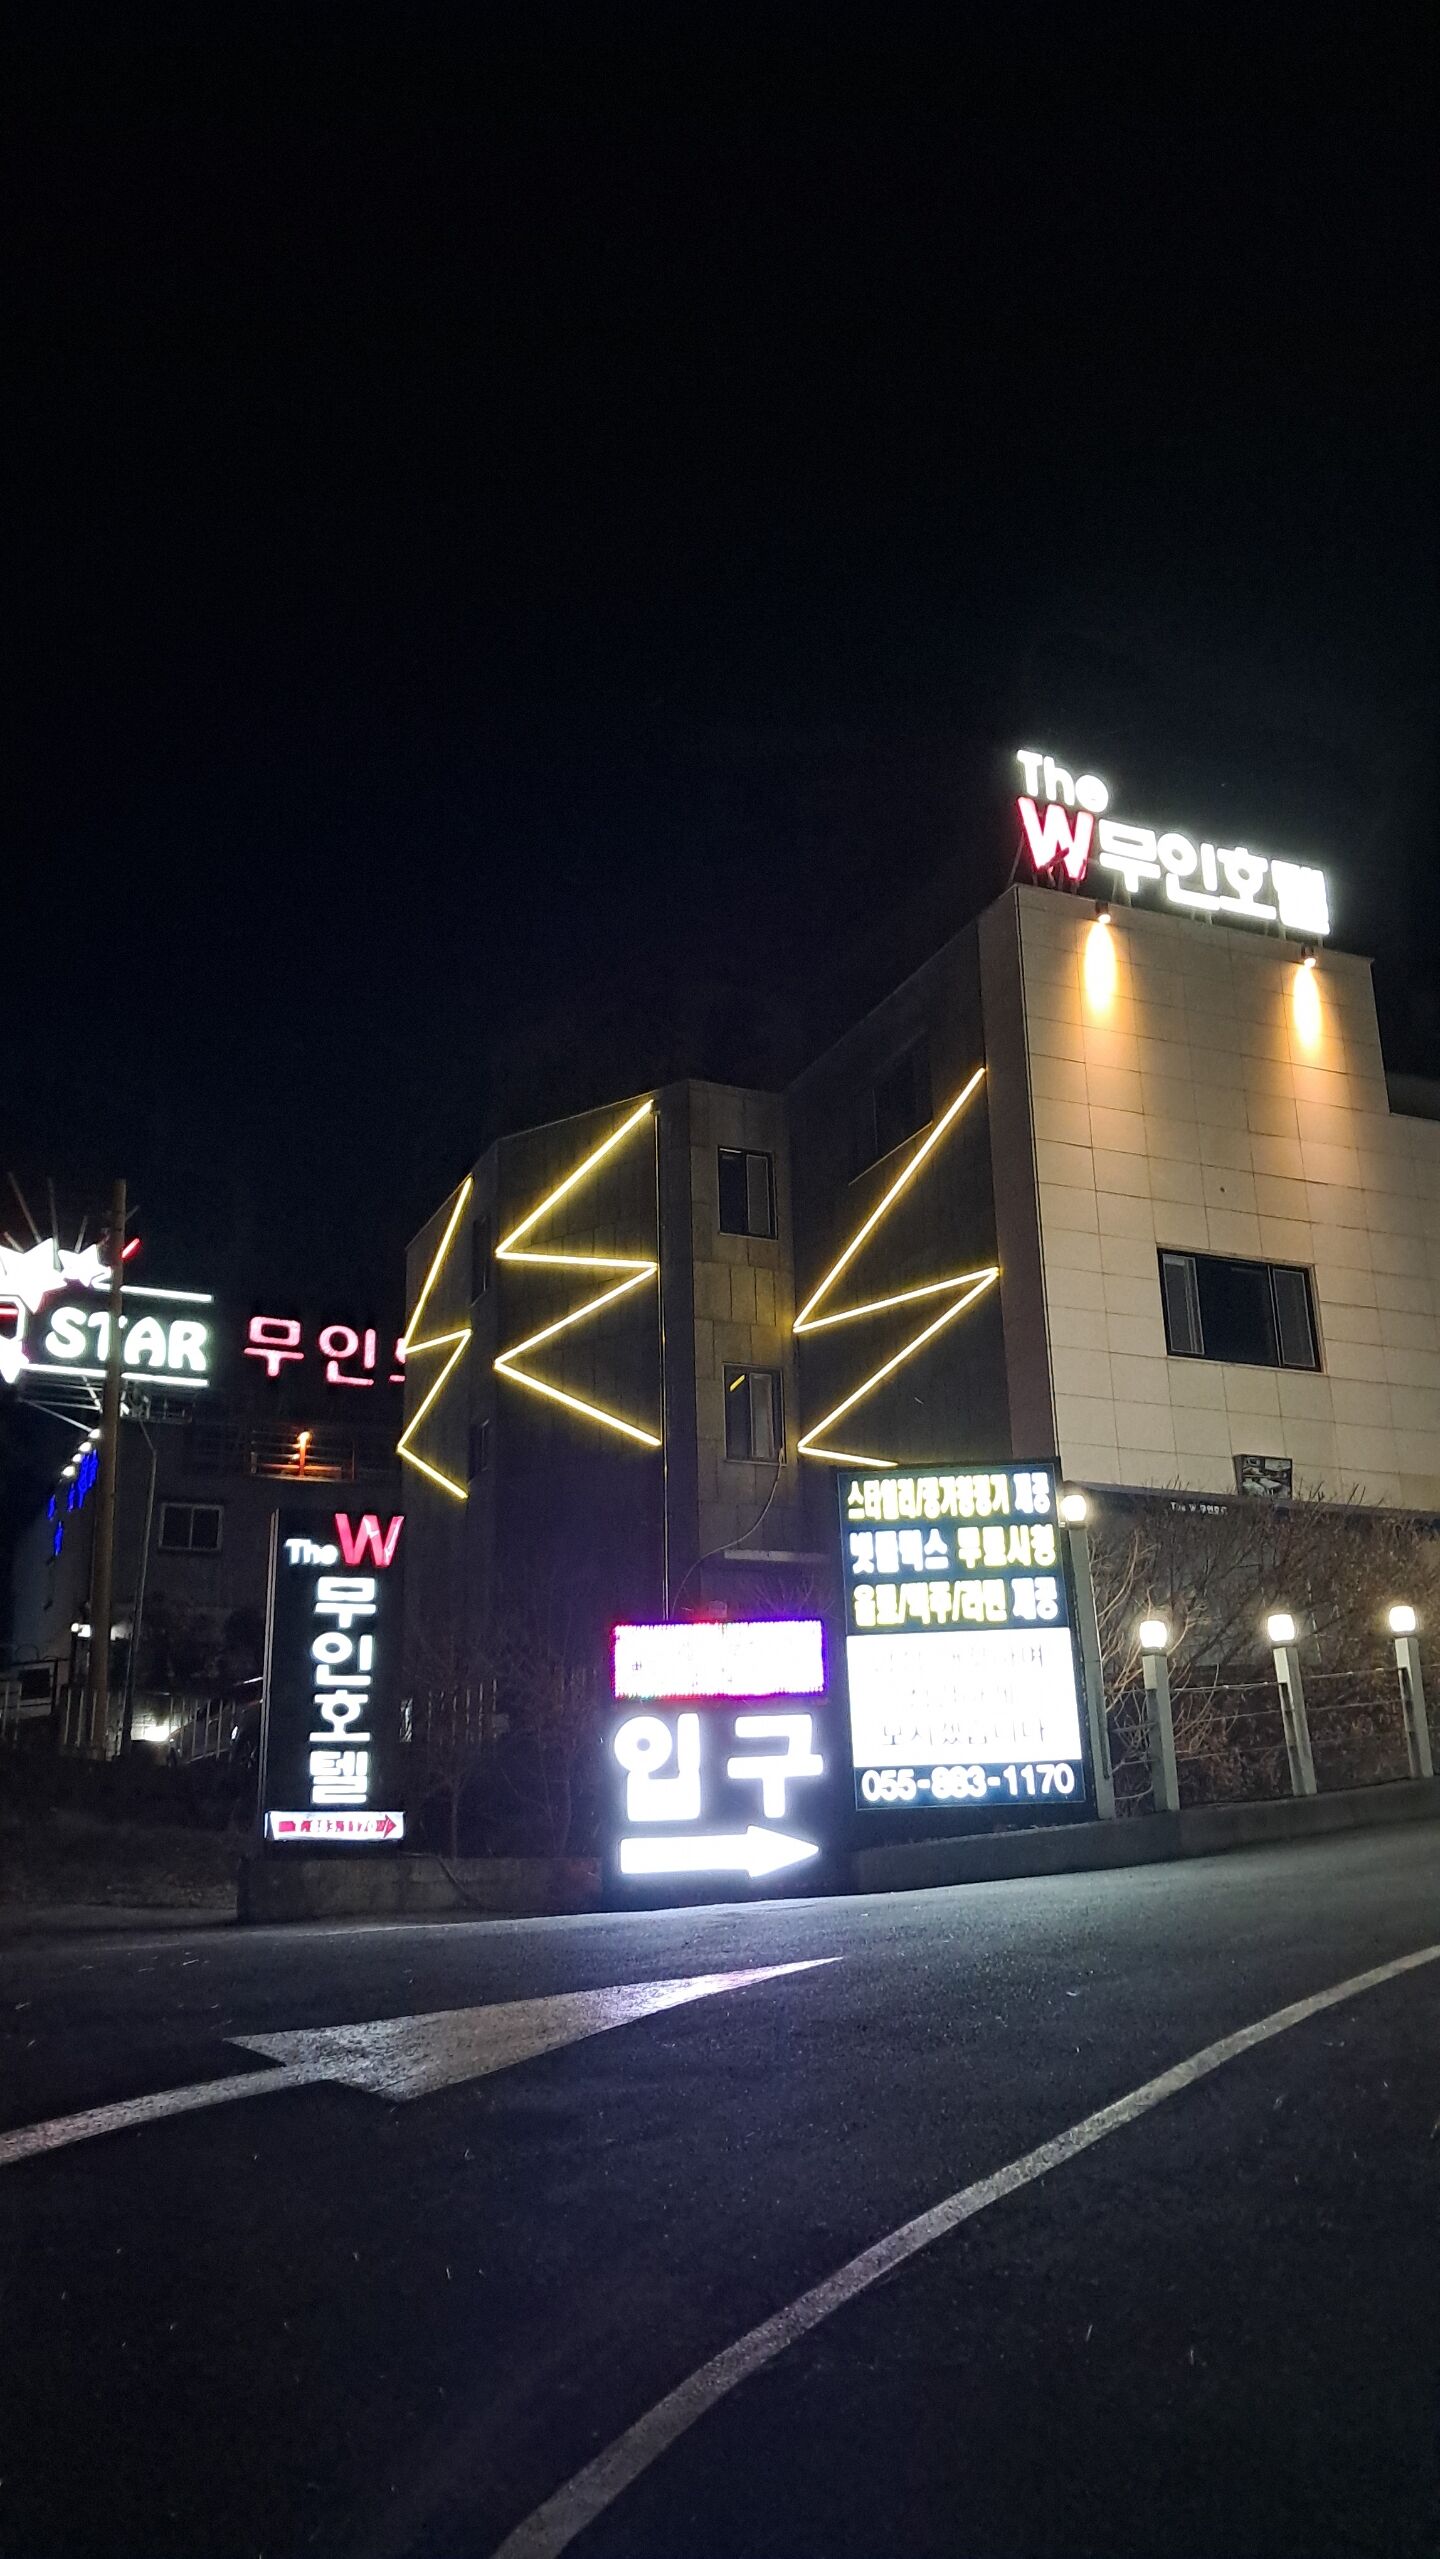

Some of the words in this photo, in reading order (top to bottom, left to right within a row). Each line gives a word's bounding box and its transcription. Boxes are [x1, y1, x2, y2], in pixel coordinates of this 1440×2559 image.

[1017, 750, 1109, 813] The
[1017, 796, 1095, 881] W
[45, 1306, 208, 1371] STAR
[285, 1538, 338, 1566] The
[335, 1513, 404, 1568] W
[957, 1524, 1056, 1568] 무료시청
[310, 1577, 376, 1804] 무인호텔
[614, 1713, 824, 1822] 입구
[862, 1763, 1075, 1802] 055-883-1170
